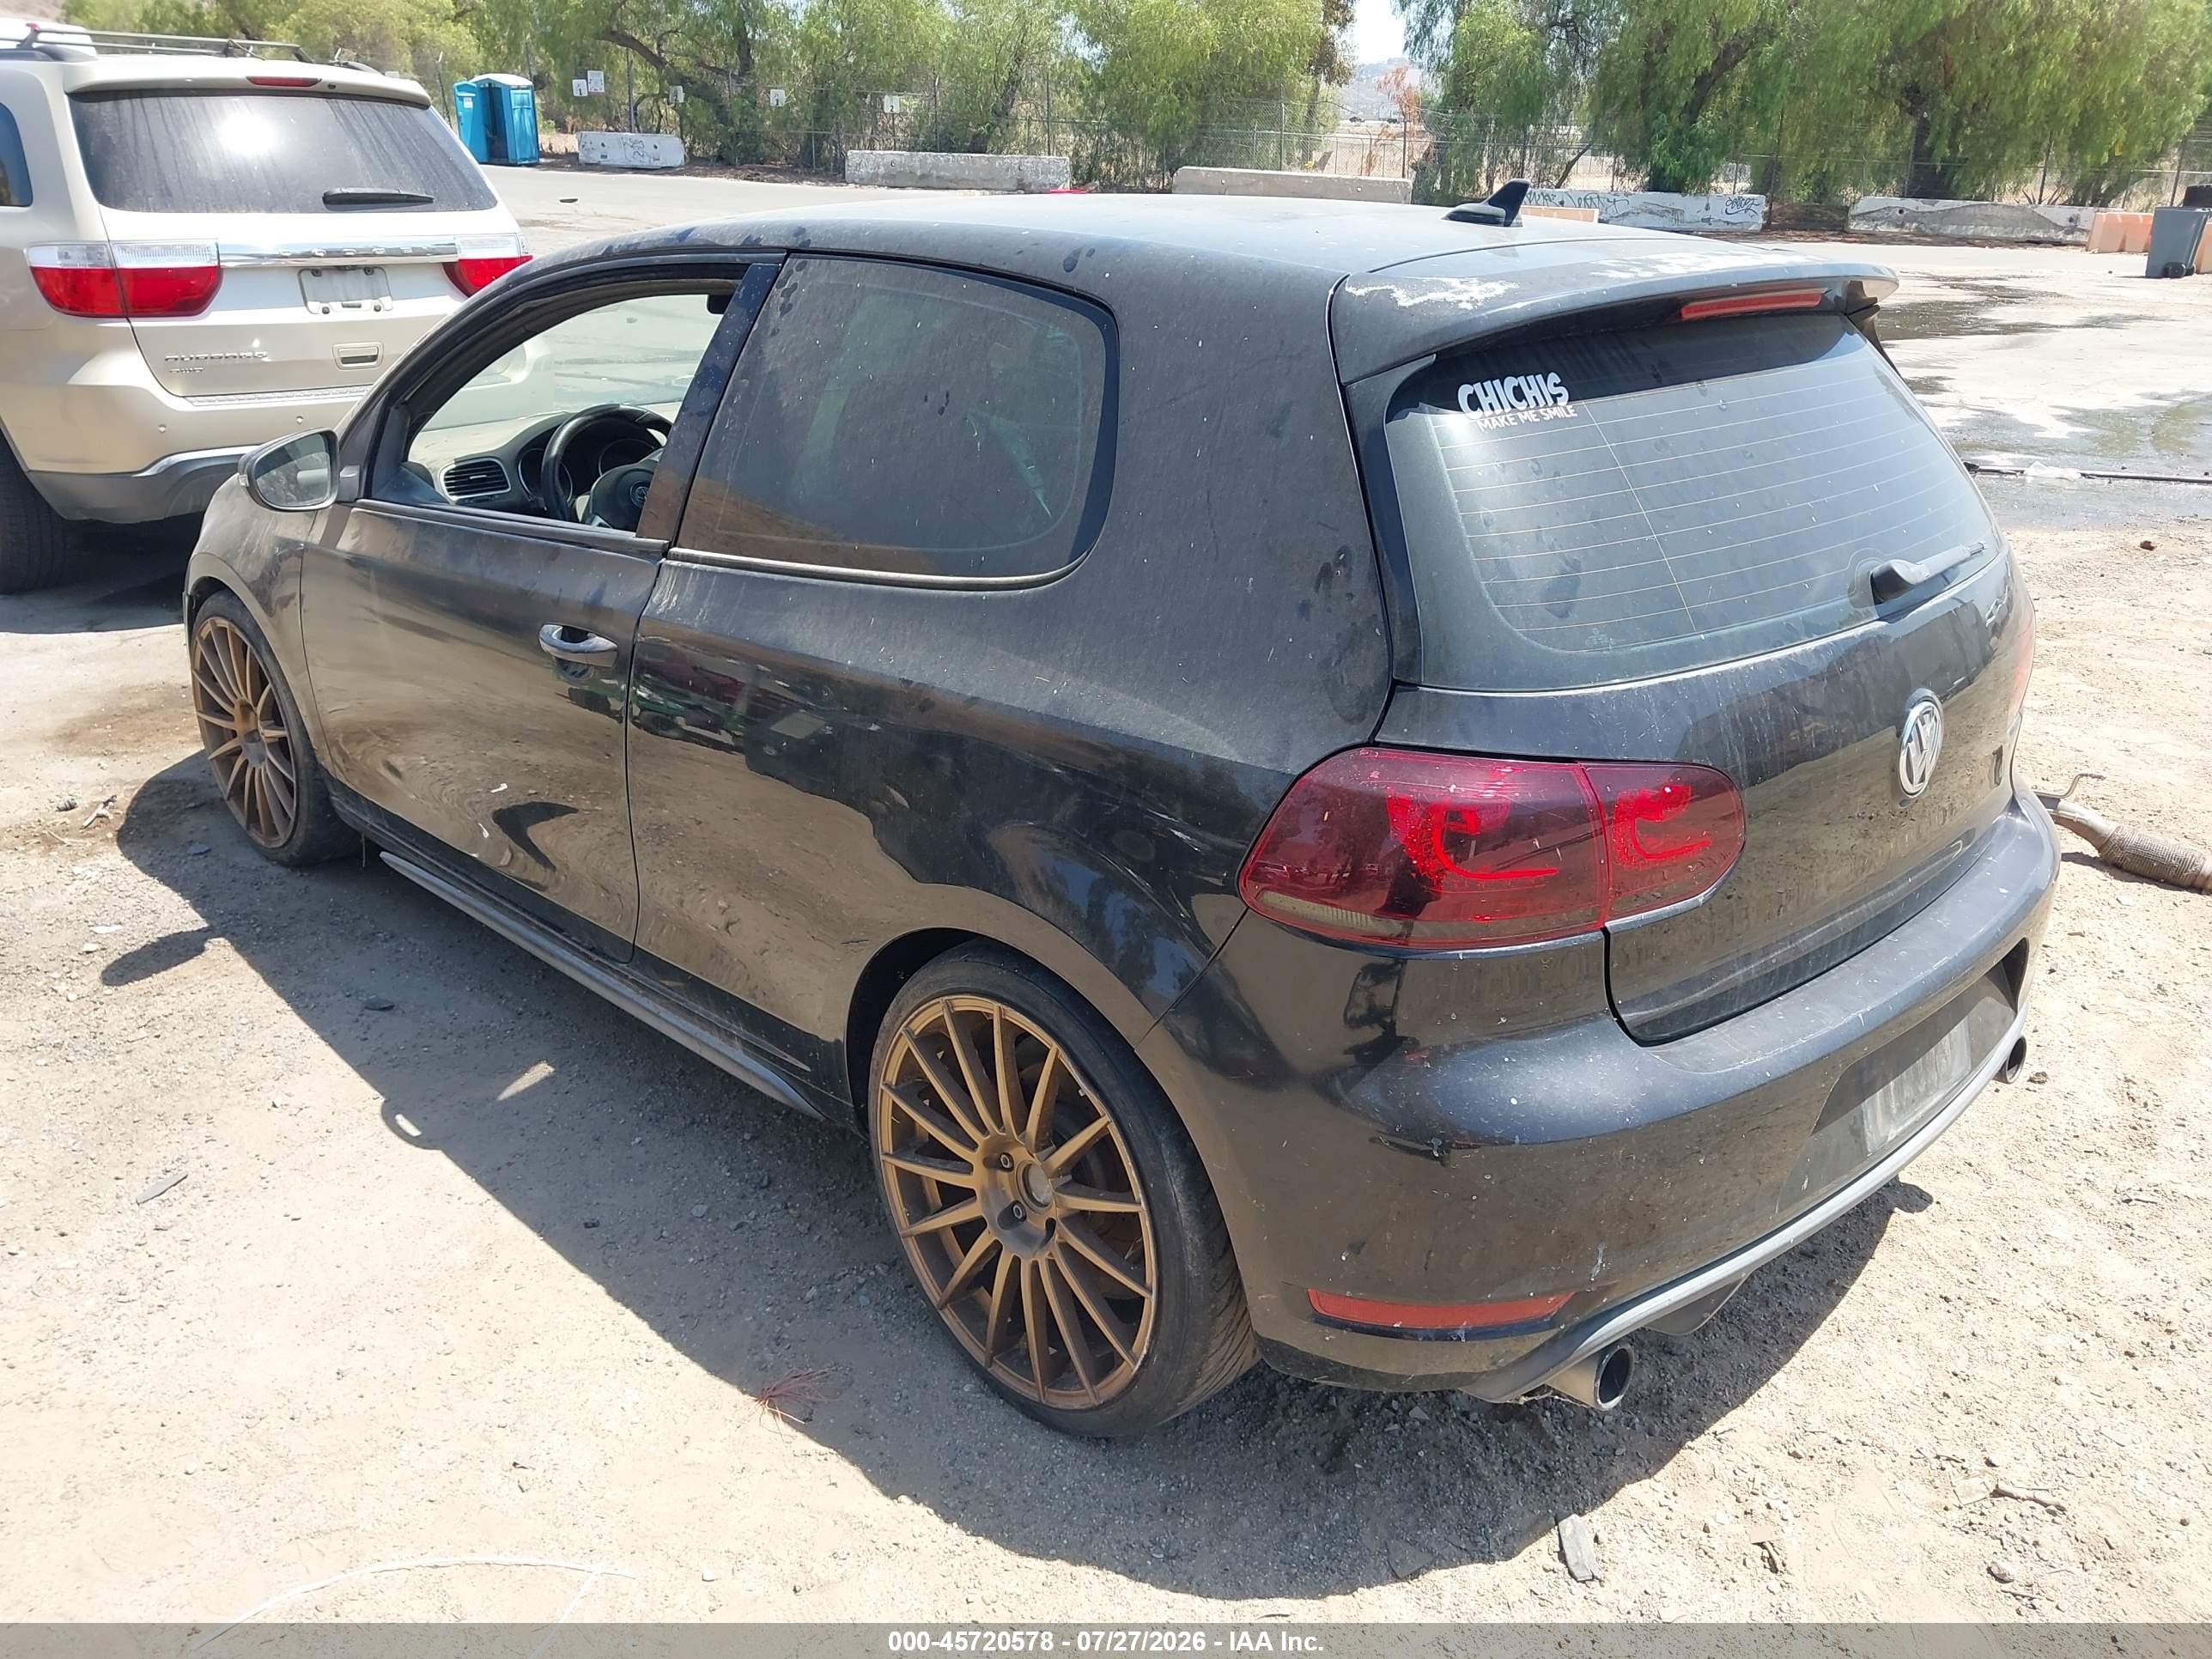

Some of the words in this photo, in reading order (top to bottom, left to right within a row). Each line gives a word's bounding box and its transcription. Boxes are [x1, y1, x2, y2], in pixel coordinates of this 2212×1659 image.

[1457, 372, 1570, 420] CHICHIS
[1477, 413, 1518, 433] MAKE
[1517, 410, 1540, 424] ME
[1540, 404, 1578, 421] SMILE
